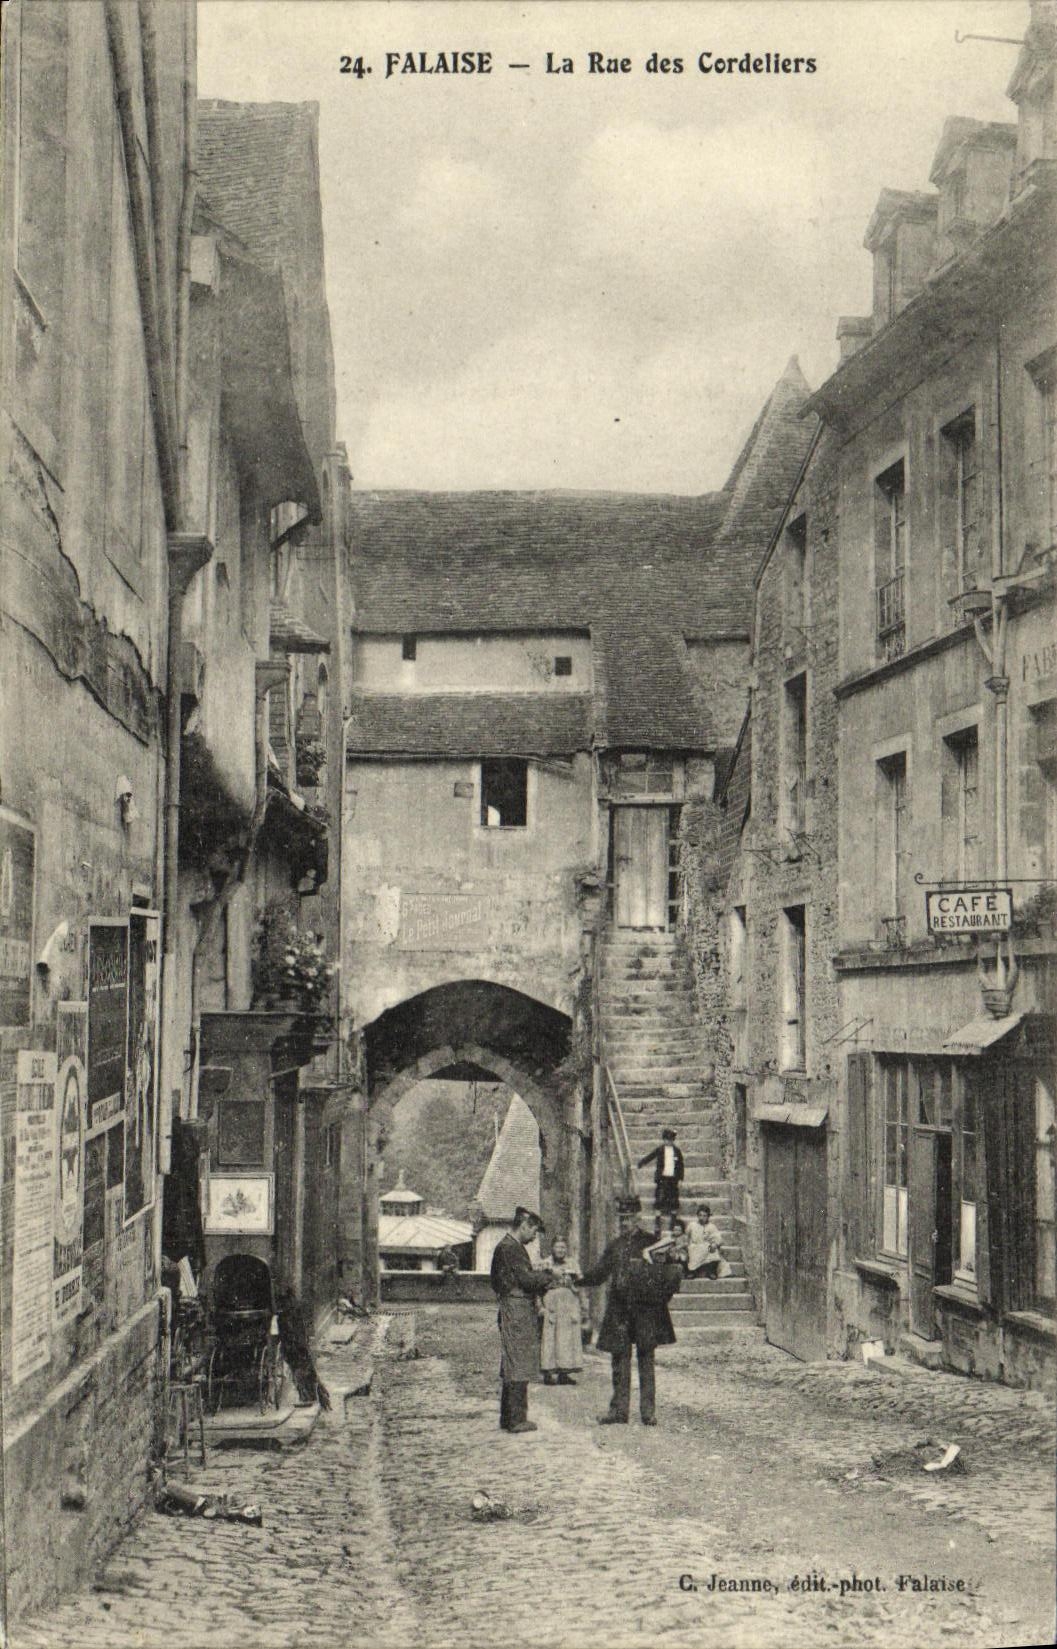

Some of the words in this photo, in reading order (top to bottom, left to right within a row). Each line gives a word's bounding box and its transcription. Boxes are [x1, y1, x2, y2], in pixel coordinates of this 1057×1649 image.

[416, 912, 439, 941] Petit
[442, 899, 481, 930] Journal
[932, 912, 1009, 929] RESTAURANT
